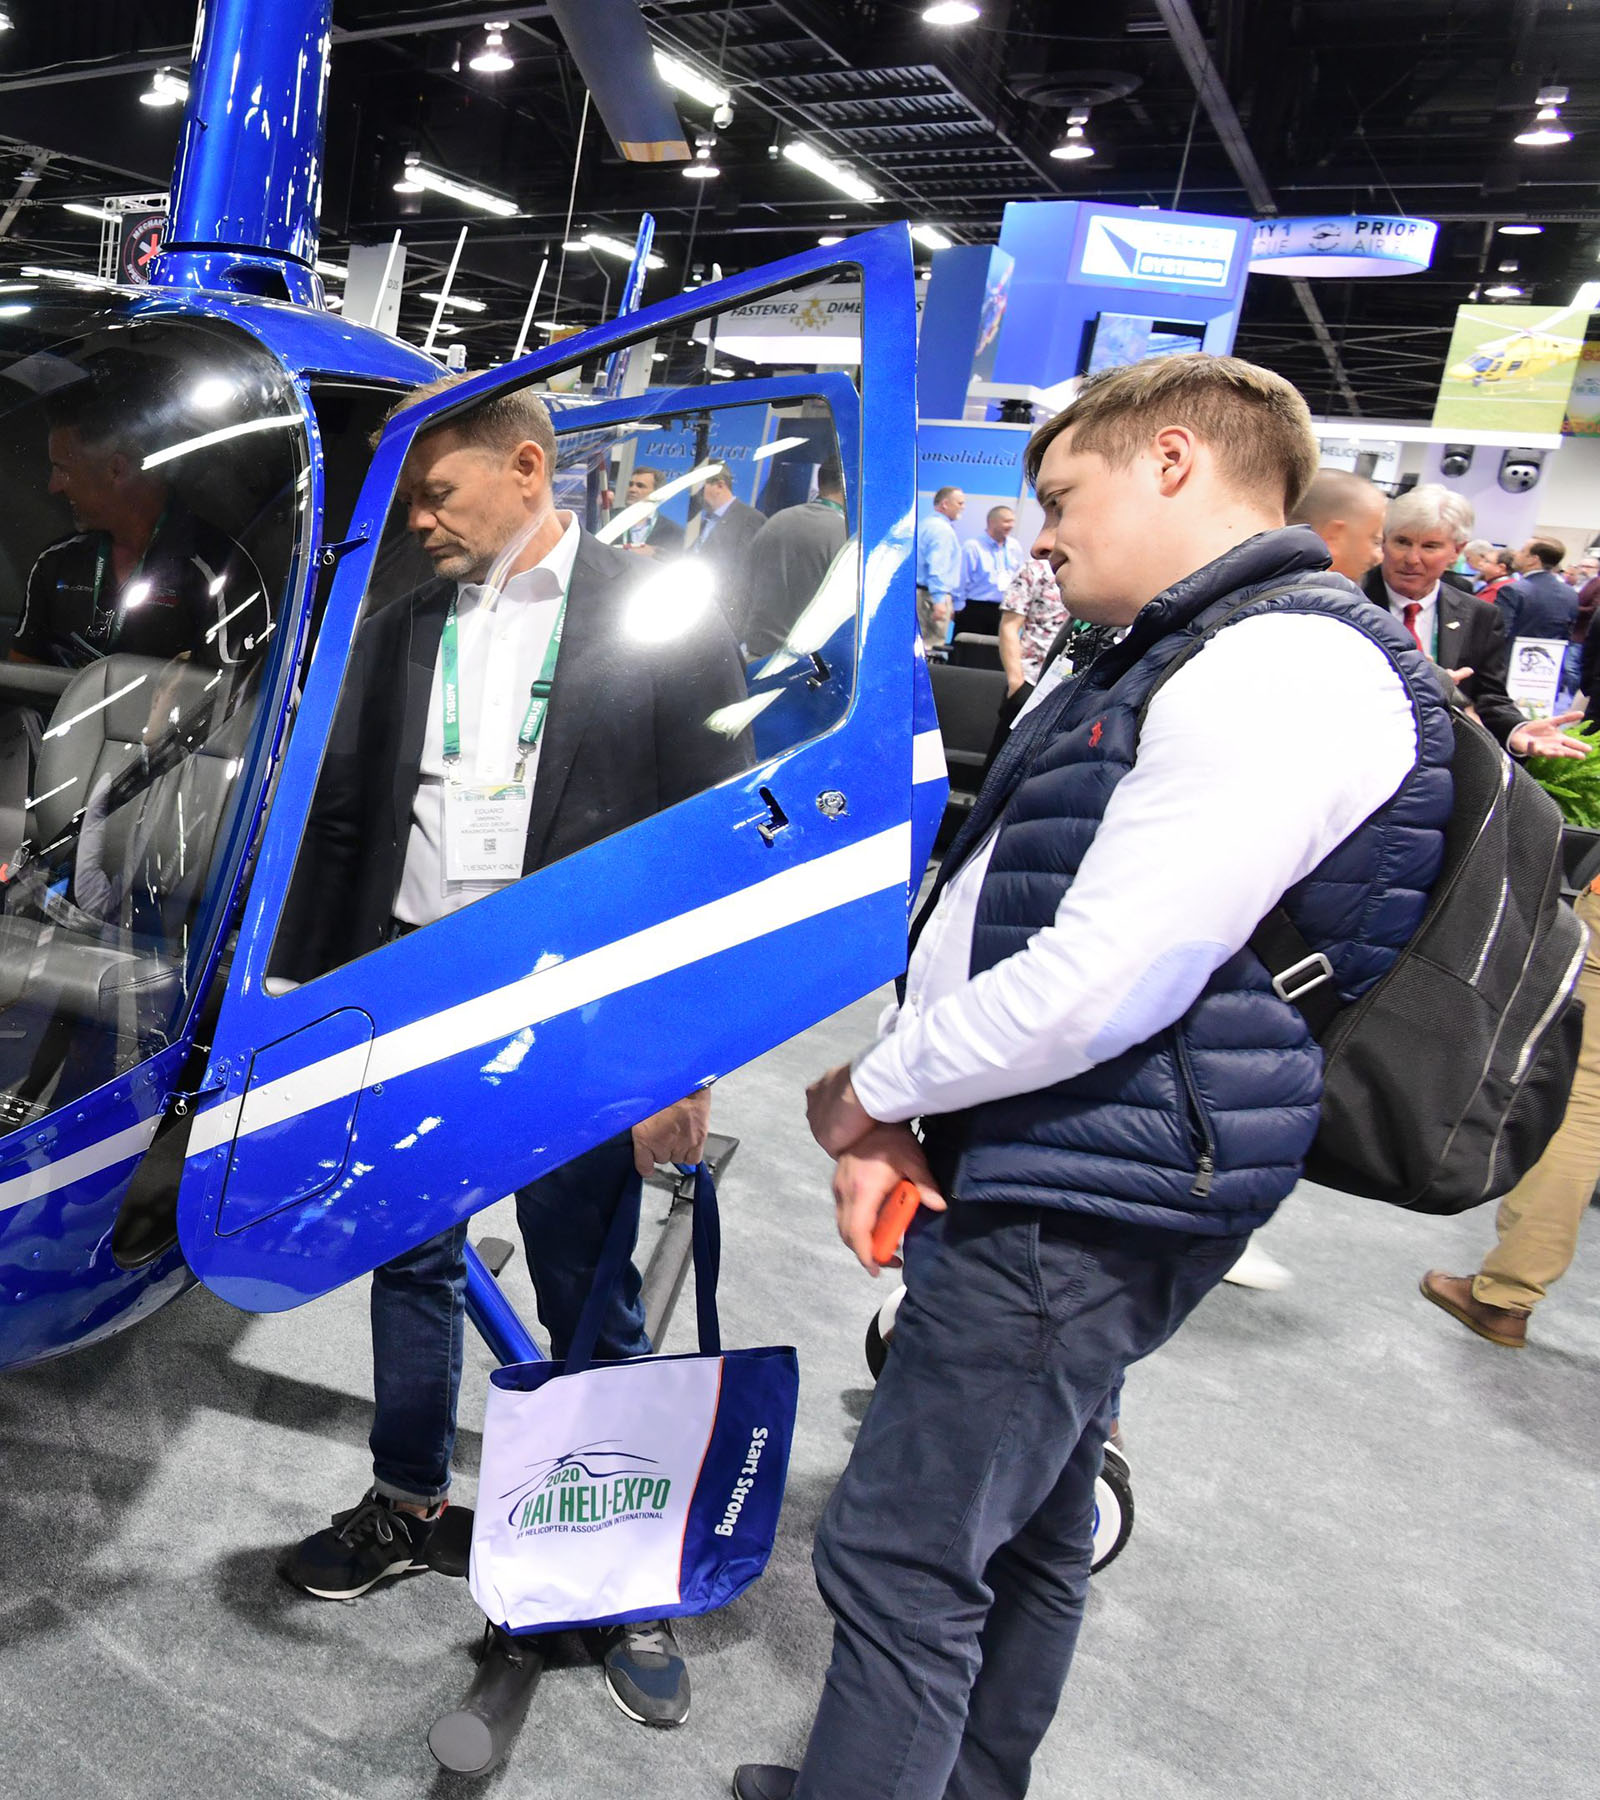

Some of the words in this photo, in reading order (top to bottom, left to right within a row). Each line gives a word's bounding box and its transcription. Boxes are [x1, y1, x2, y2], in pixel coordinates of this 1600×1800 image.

[730, 303, 799, 317] FASTENER
[445, 682, 457, 725] AIRBUS
[521, 700, 544, 743] AIRBUS
[463, 864, 498, 872] TUESDAY
[499, 863, 521, 871] ONLY
[741, 1427, 769, 1475] Start
[545, 1467, 580, 1489] 2020
[519, 1490, 554, 1531] HAI
[559, 1478, 672, 1523] HELI-EXPO
[525, 1524, 569, 1538] HELICOPTER
[614, 1511, 664, 1529] INTERNATIONAL
[714, 1477, 754, 1537] Strong
